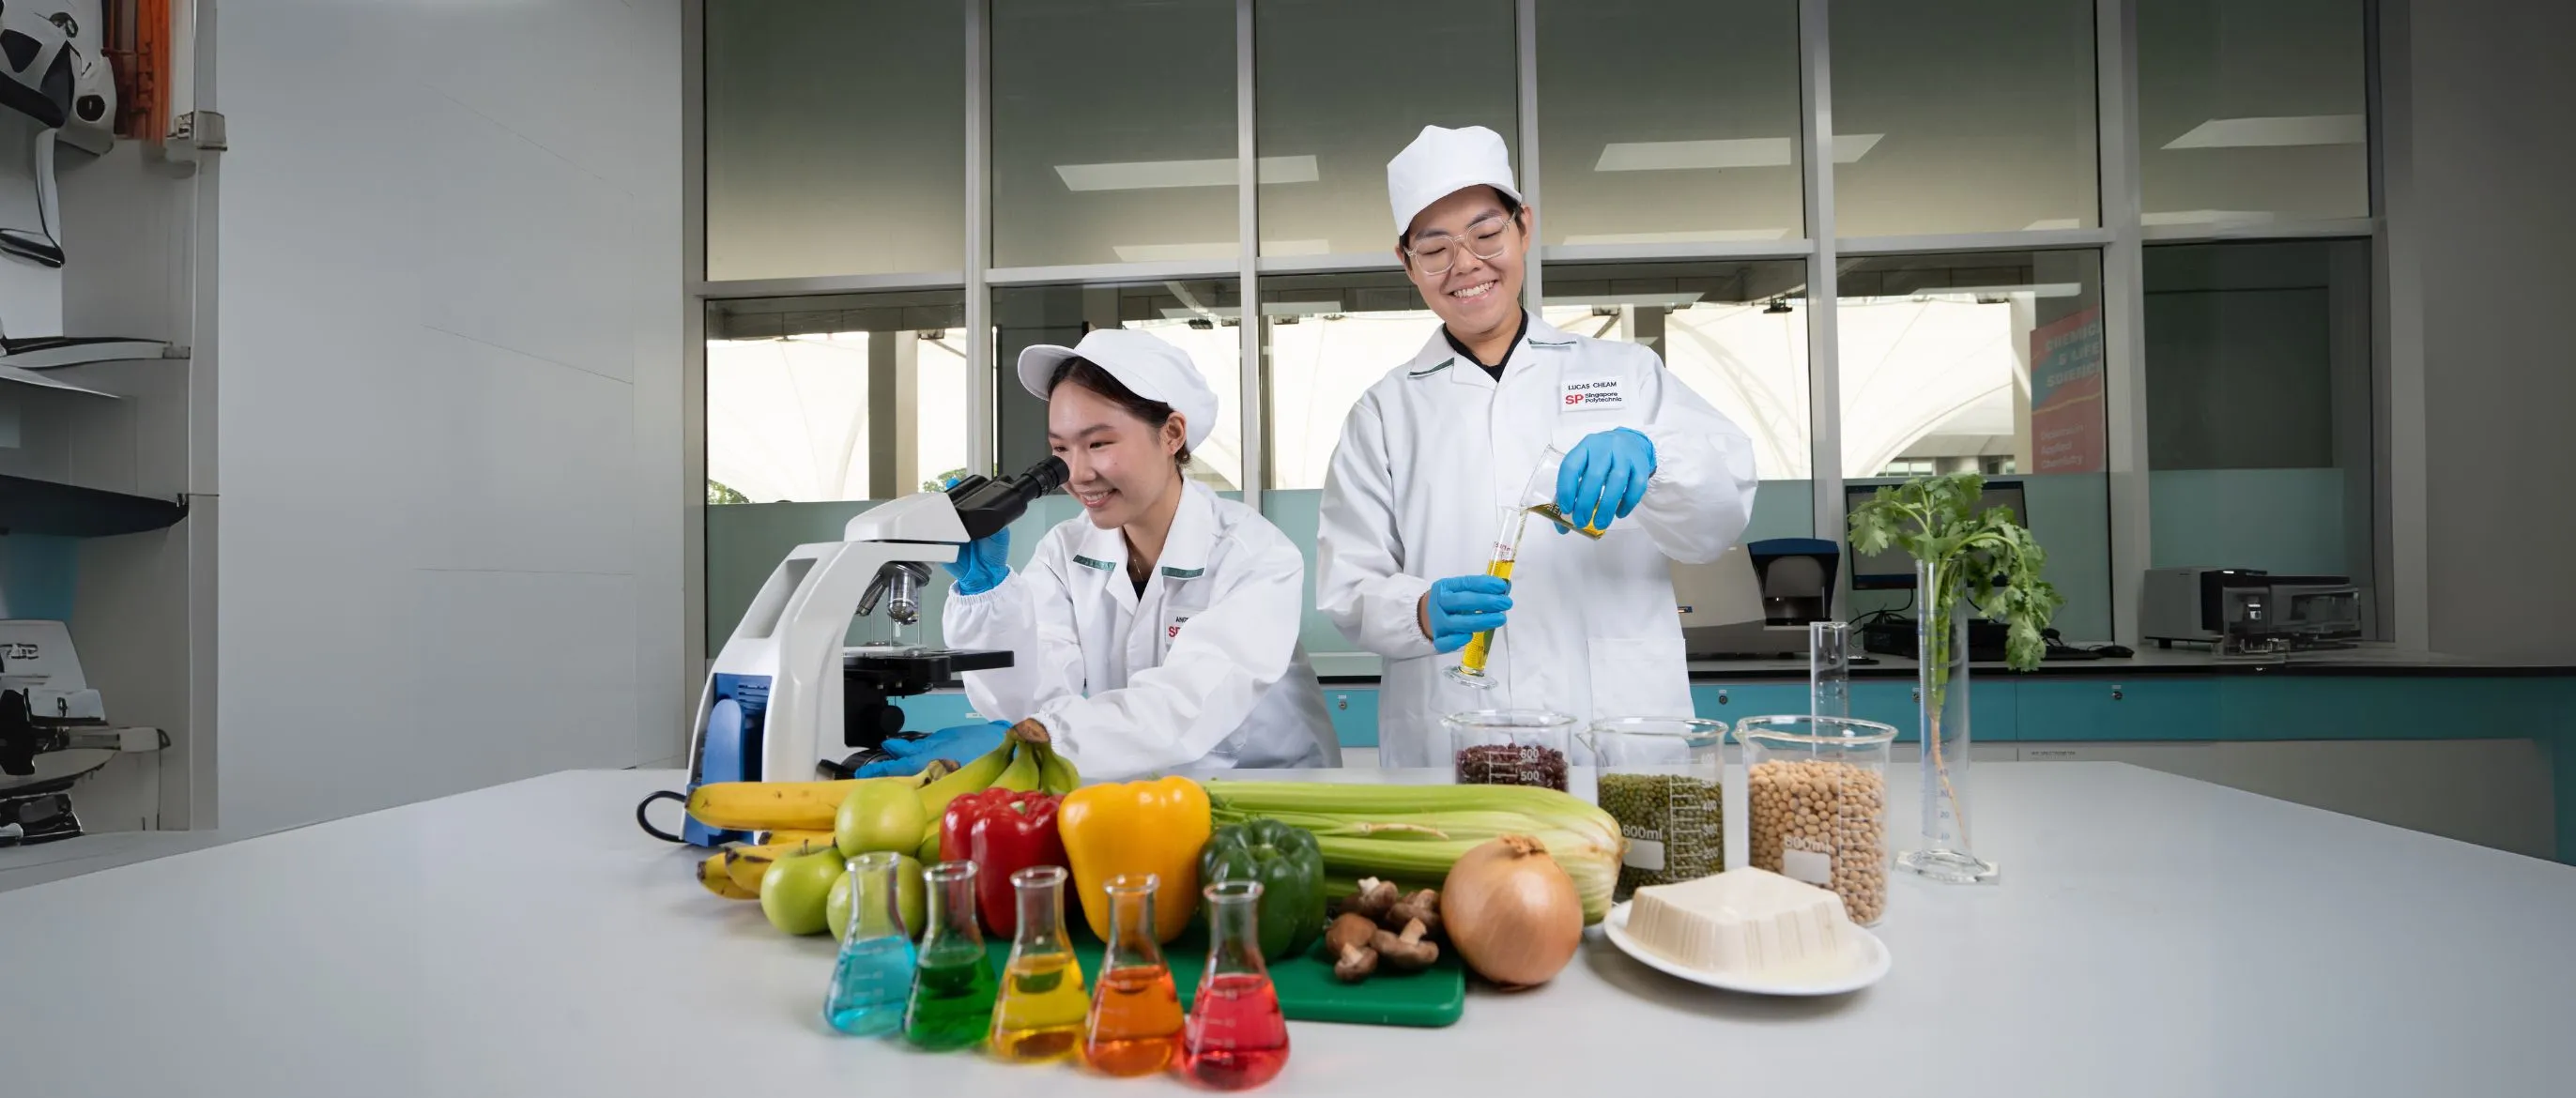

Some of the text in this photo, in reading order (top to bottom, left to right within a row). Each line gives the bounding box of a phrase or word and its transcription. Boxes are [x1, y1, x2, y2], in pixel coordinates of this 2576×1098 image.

[2047, 323, 2100, 351] CHEMIC
[1565, 394, 1584, 404] SP
[1520, 748, 1541, 759] 600
[1520, 770, 1541, 781] 500
[1622, 825, 1664, 842] 600ml
